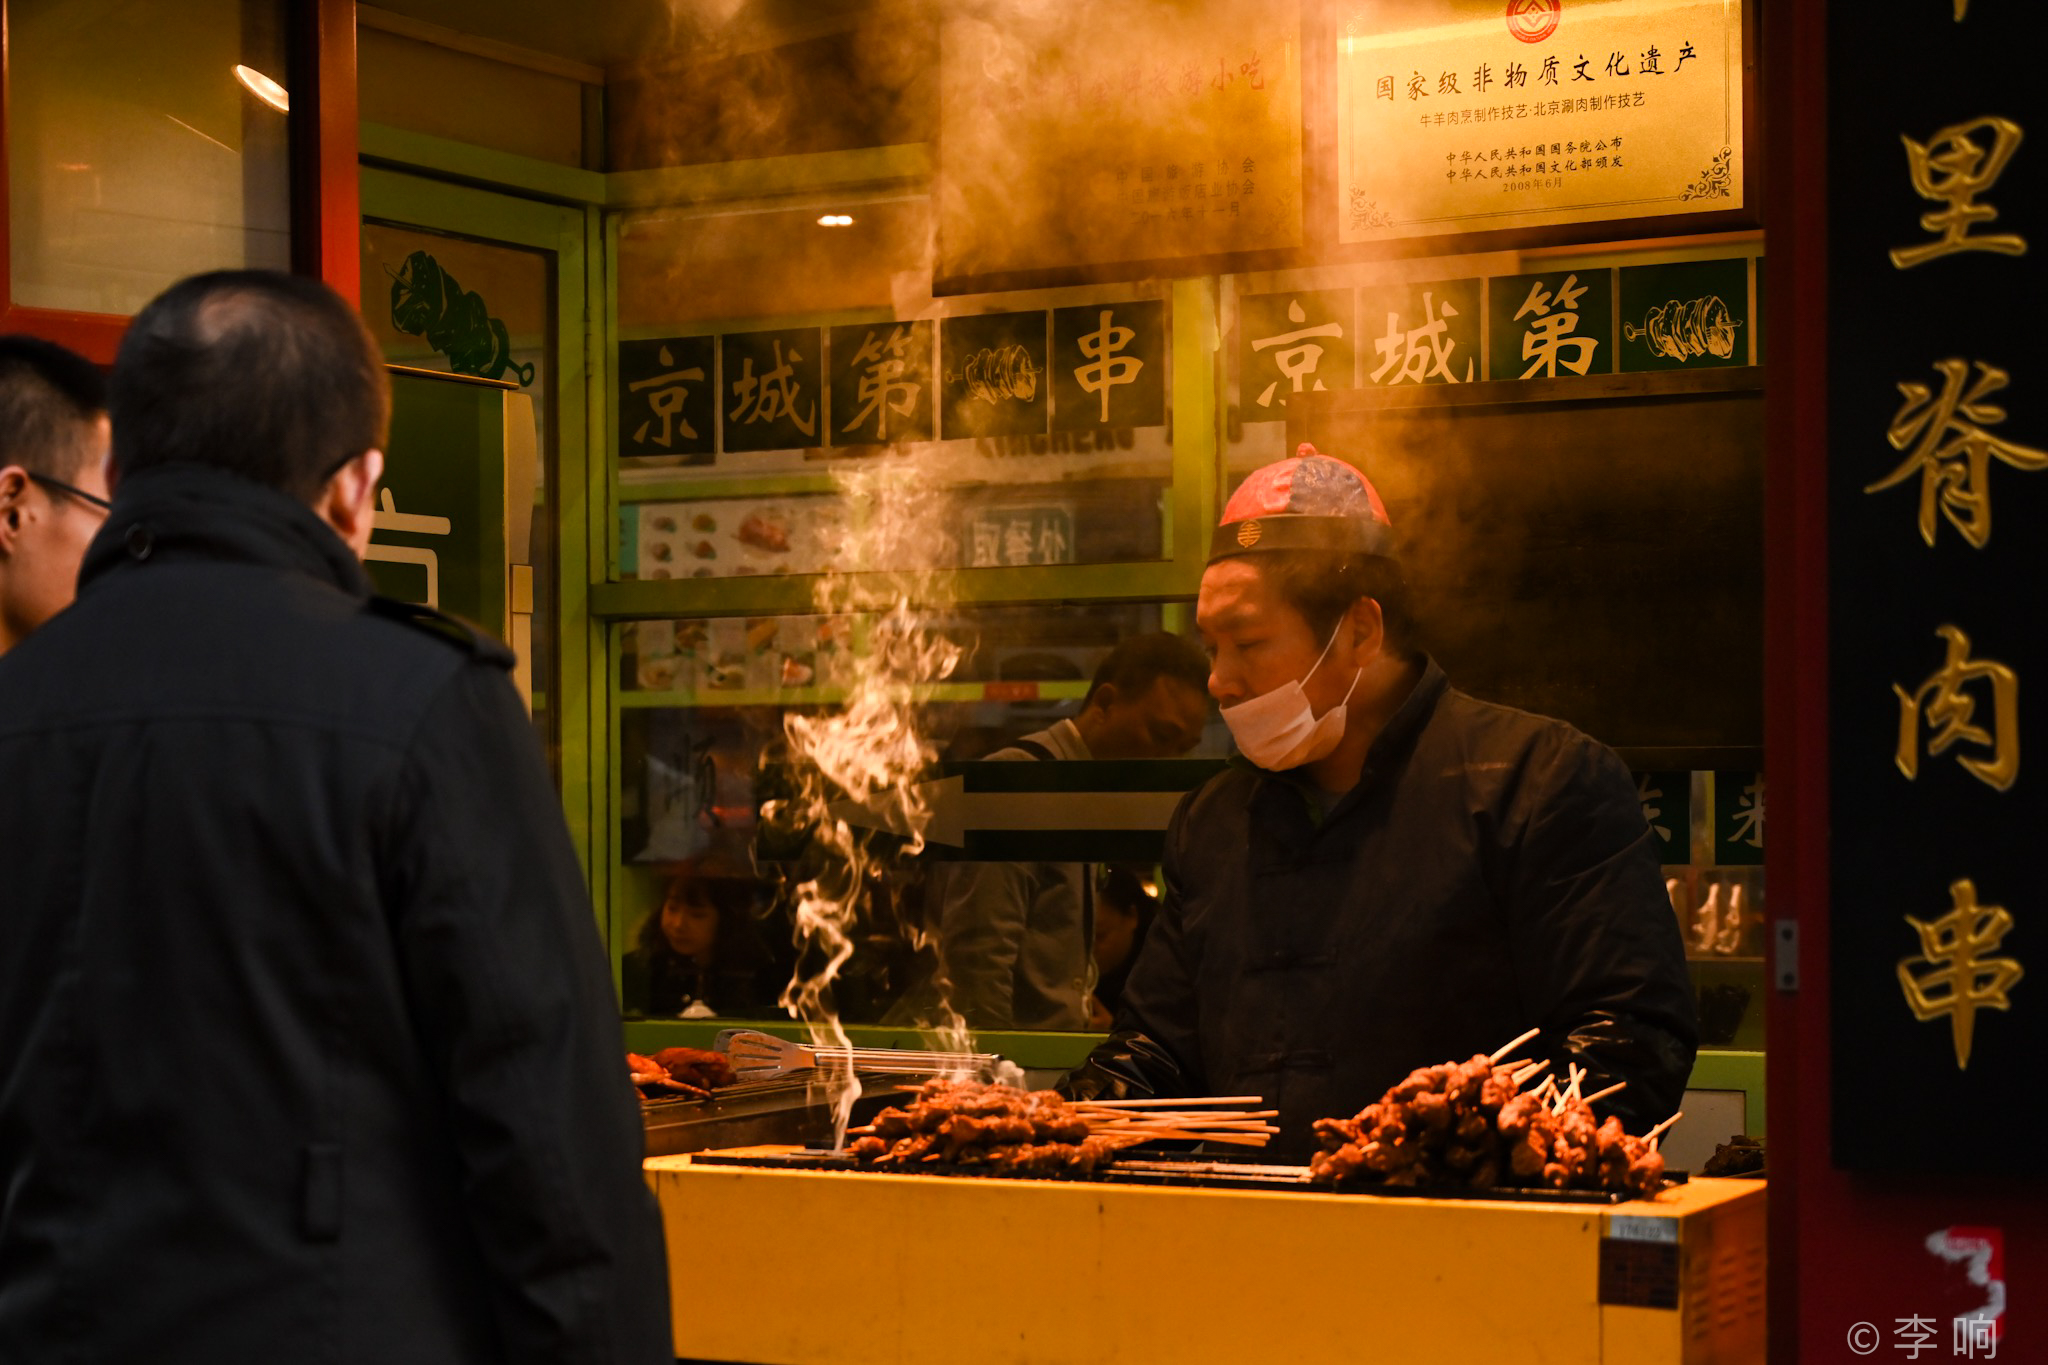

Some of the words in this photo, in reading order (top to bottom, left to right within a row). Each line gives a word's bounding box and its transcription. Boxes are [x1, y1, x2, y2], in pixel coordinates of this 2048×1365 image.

[1375, 40, 1698, 102] 国家级非物质文化遗产
[1445, 135, 1624, 165] 中华人民共和国国务院公布
[1445, 154, 1625, 184] 中华人民共和国文化部颁发
[1502, 177, 1563, 194] 2008年6月
[1864, 0, 2048, 1072] 里脊肉串
